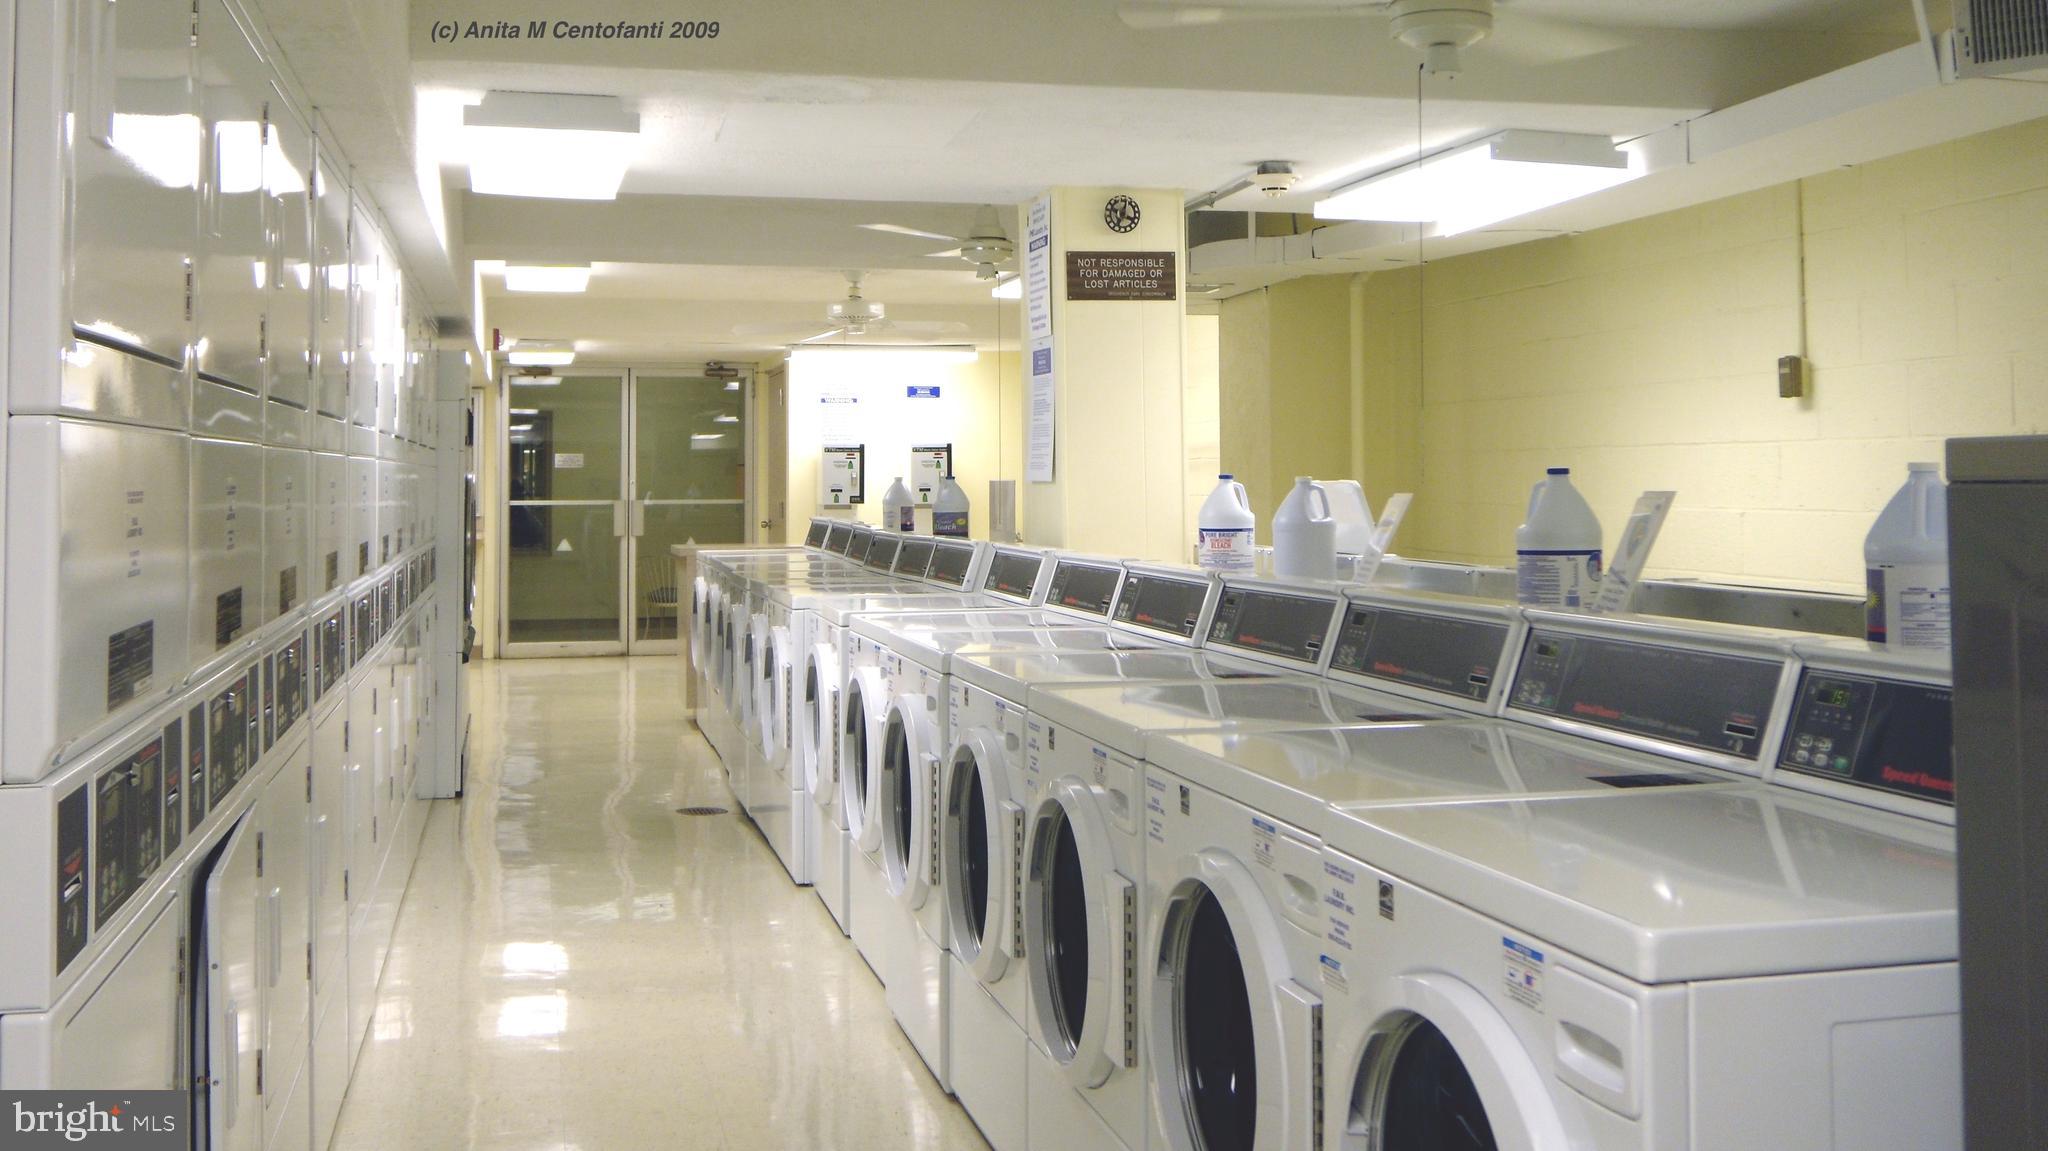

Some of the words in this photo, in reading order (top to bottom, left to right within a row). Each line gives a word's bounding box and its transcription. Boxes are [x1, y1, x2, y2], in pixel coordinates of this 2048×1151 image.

[1077, 258, 1097, 268] NOT
[1100, 258, 1165, 268] RESPONSIBLE
[1079, 269, 1099, 278] FOR
[1102, 269, 1146, 278] DAMAGED
[1149, 269, 1163, 278] OR
[1084, 280, 1109, 289] LOST
[1113, 280, 1158, 289] ARTICLES
